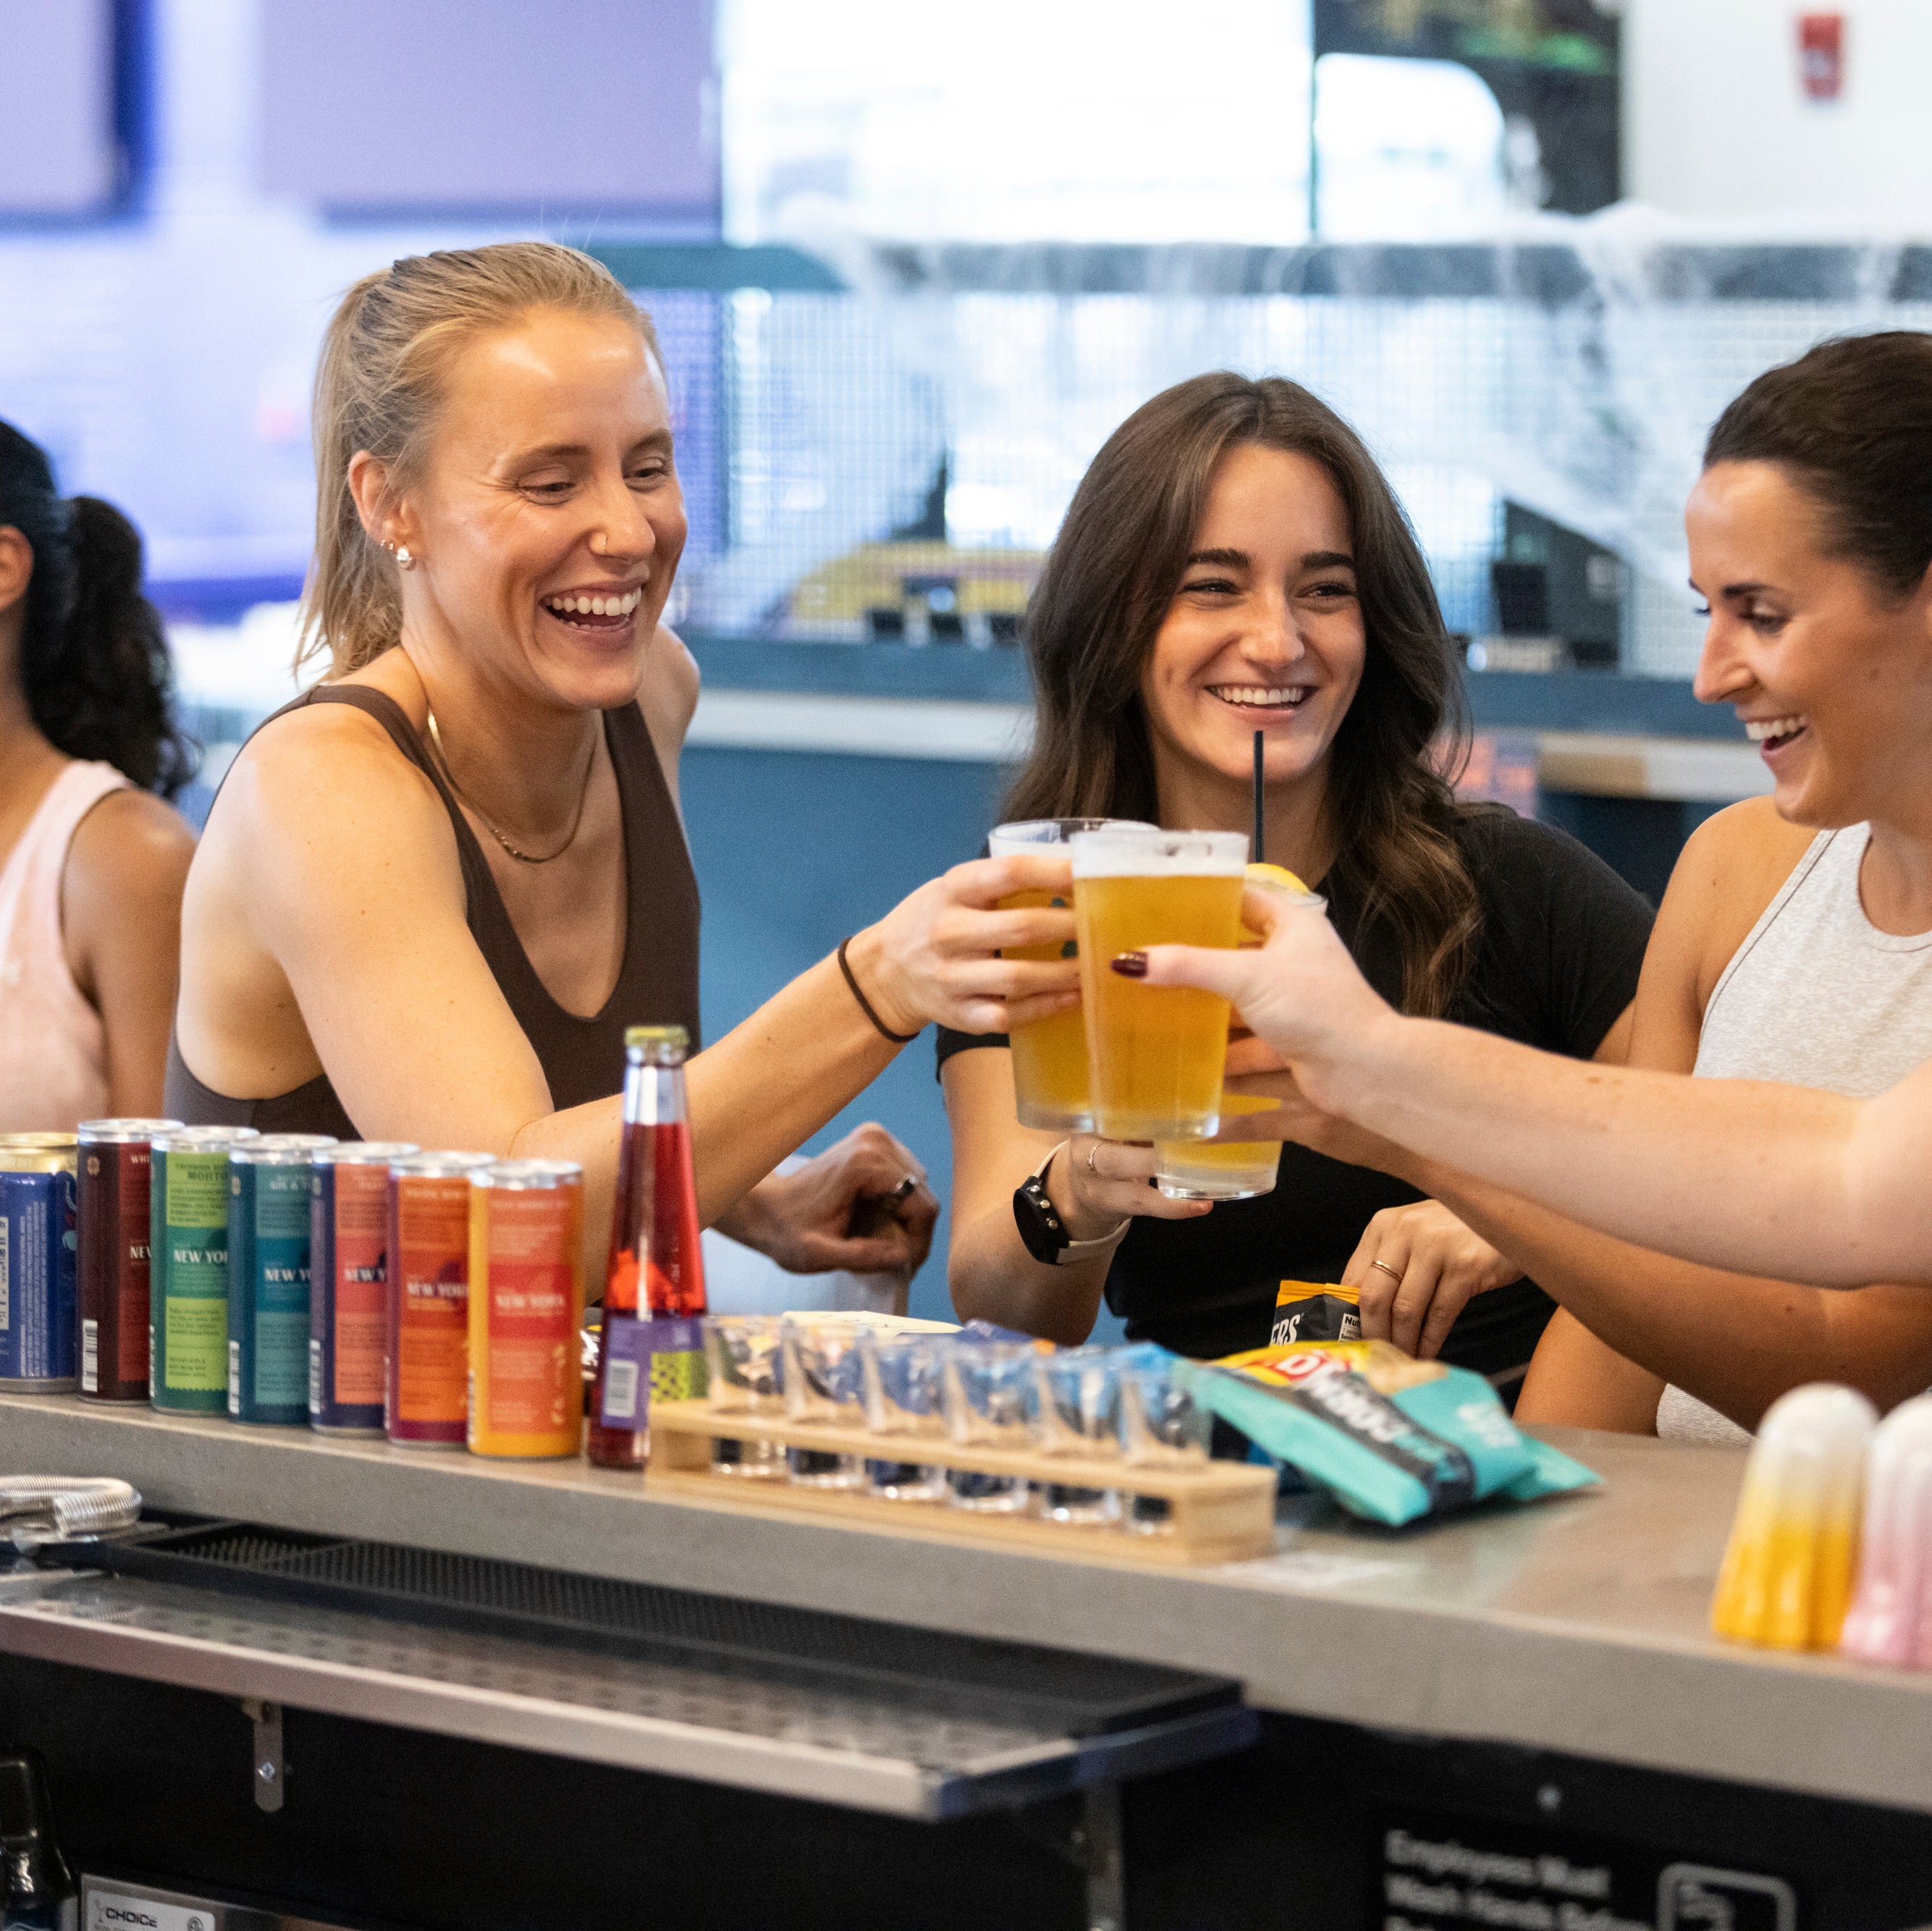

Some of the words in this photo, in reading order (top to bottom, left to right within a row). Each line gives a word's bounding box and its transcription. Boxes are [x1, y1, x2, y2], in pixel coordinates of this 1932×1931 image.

[174, 1249, 201, 1263] NEW
[265, 1268, 295, 1282] NEW
[344, 1267, 374, 1283] NEW
[406, 1283, 434, 1296] NEW
